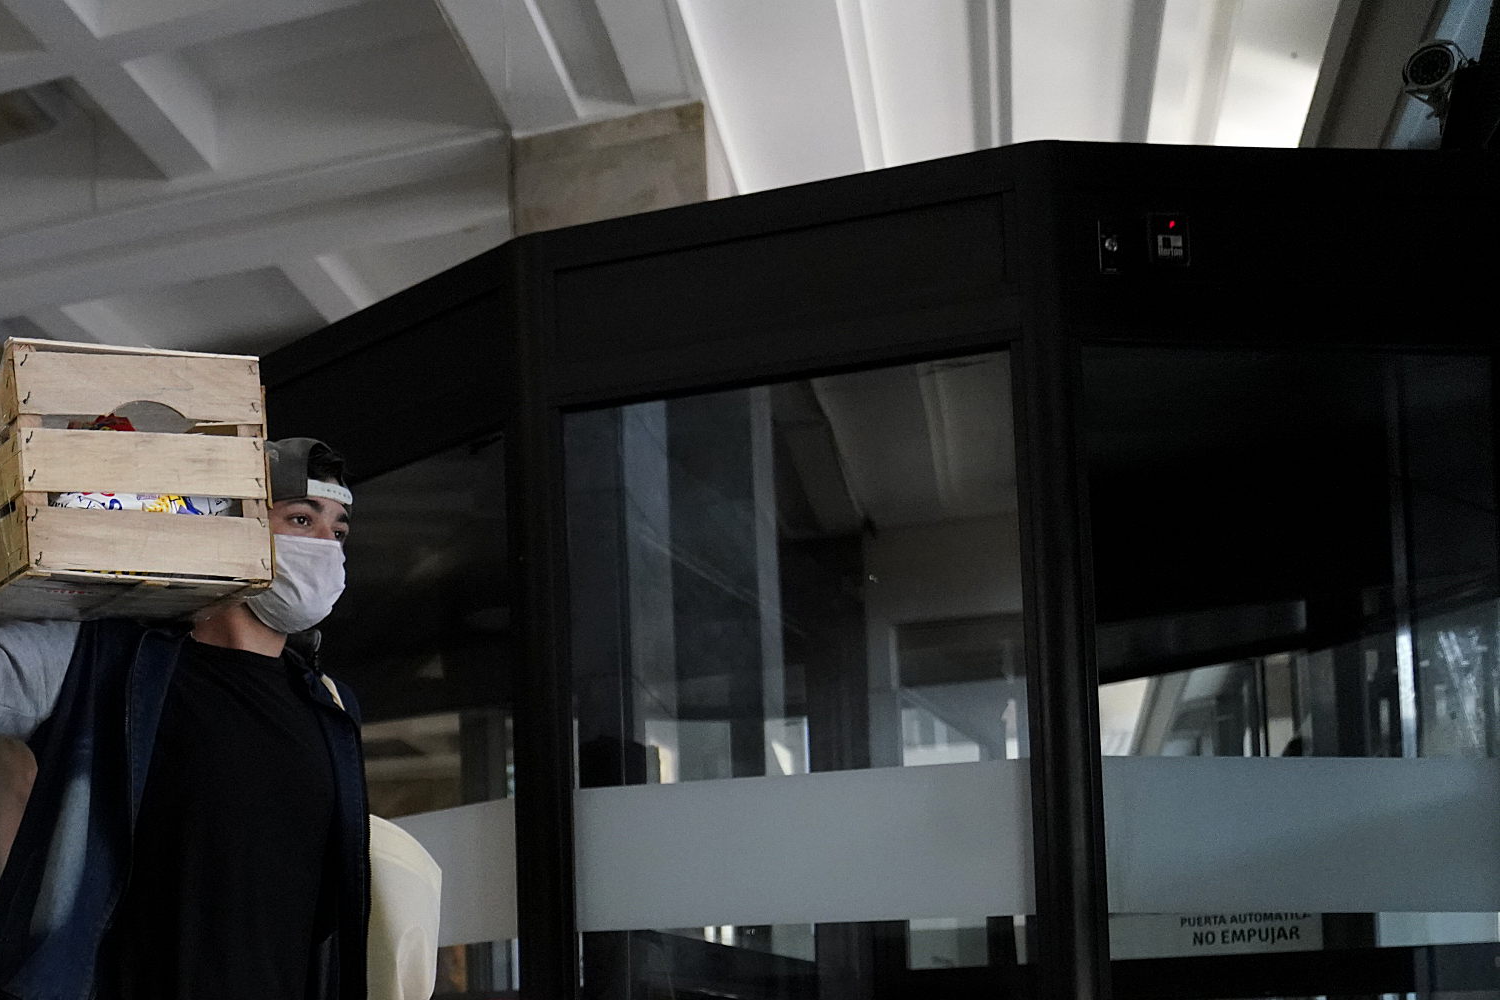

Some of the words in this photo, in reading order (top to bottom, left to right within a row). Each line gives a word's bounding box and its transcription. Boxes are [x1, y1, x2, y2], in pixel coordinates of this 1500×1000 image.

[1179, 914, 1226, 927] PUERTA
[1192, 930, 1216, 945] NO
[1220, 925, 1300, 944] EMPUJAR
